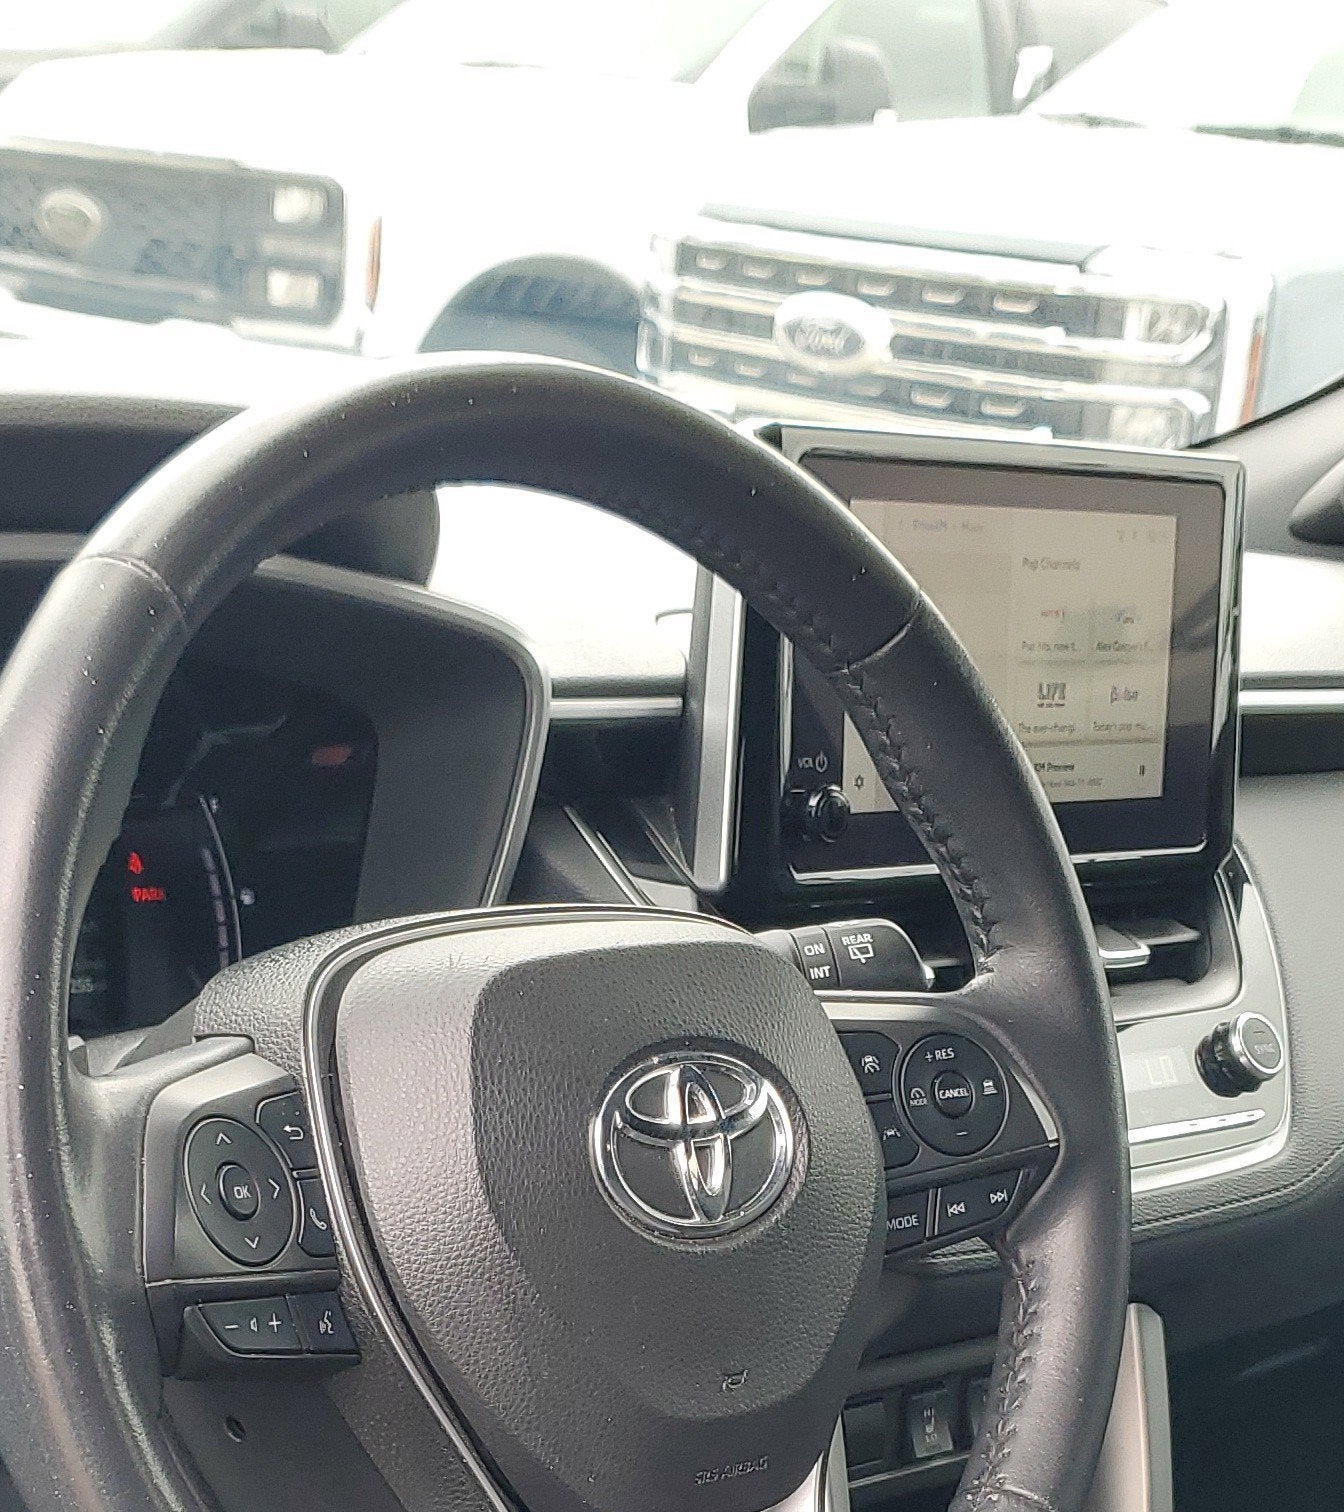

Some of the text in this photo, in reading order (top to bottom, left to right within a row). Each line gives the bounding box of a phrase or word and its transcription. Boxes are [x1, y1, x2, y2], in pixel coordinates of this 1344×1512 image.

[841, 931, 874, 947] REAR
[803, 942, 826, 958] ON
[809, 965, 832, 981] INT
[938, 1086, 969, 1100] CANCEL
[909, 1096, 930, 1107] MODE
[233, 1186, 251, 1200] OK
[886, 1212, 920, 1230] MODE
[694, 1455, 769, 1486] SRS AIRBAG
